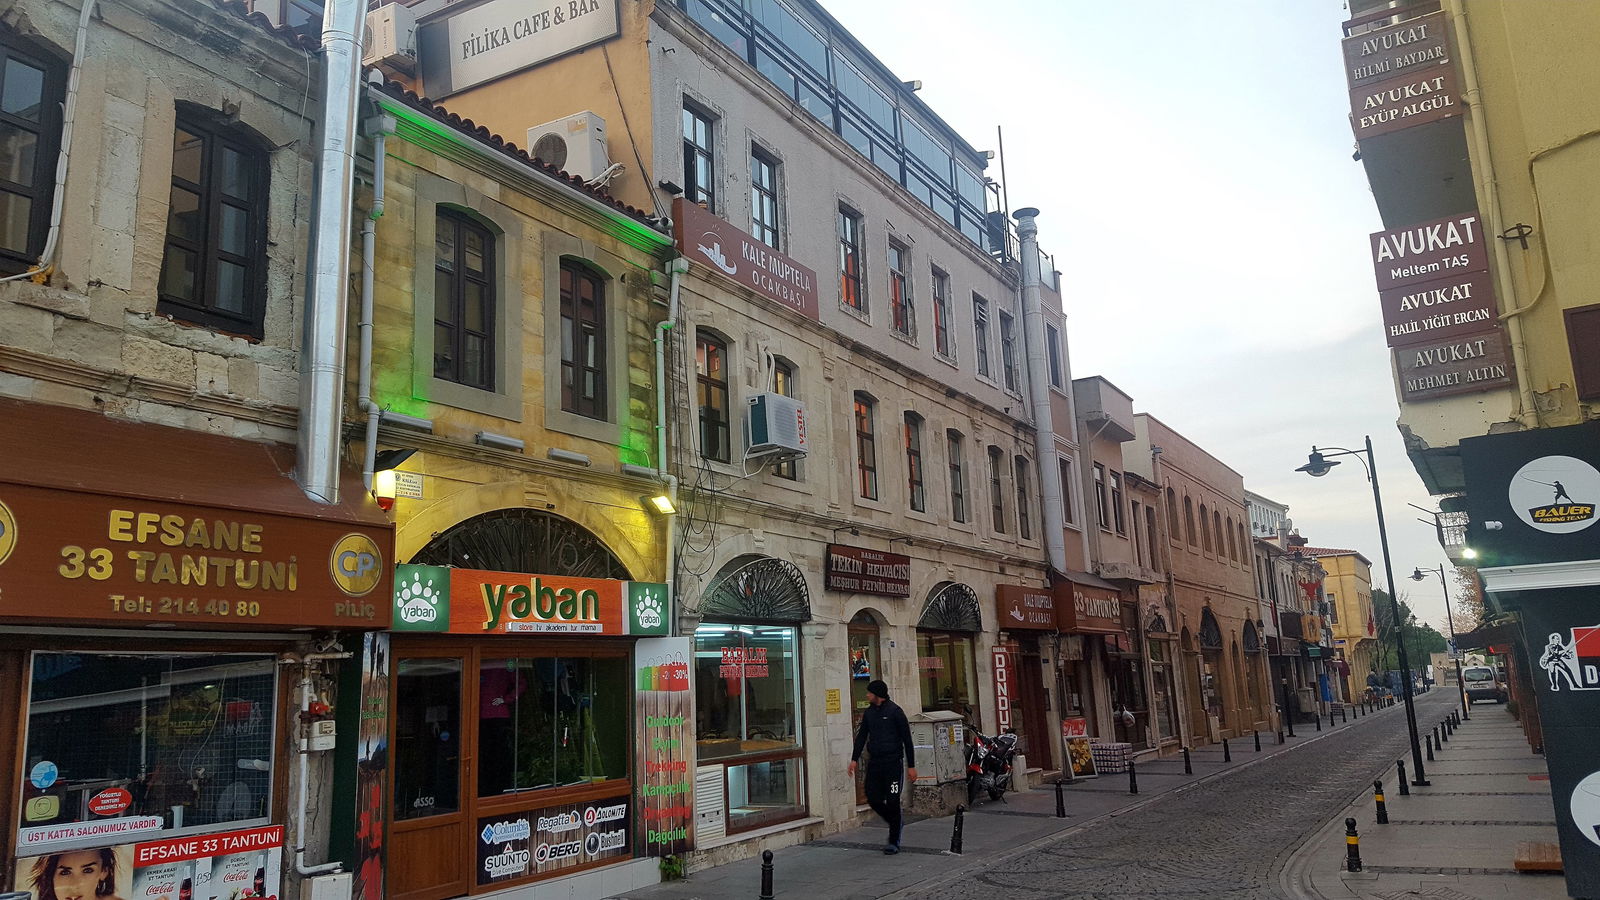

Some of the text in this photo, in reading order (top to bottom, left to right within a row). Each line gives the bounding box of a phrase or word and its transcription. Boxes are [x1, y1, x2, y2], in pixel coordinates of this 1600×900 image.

[462, 26, 511, 60] FİLİKA
[513, 10, 551, 40] CAFE
[553, 6, 565, 26] &
[1361, 24, 1428, 57] AVUKAT
[1353, 45, 1444, 80] HİLMİ BAYDAR
[1363, 76, 1445, 110] AVUKAT
[1360, 94, 1454, 129] EYÜP ALGÜL
[1377, 216, 1476, 263] AVUKAT
[742, 240, 812, 293] KALE MÜPTELA
[1391, 253, 1470, 280] Meltem TAŞ
[752, 270, 806, 309] OCAKBAŞI
[1399, 282, 1473, 313] AVUKAT
[1390, 307, 1491, 337] HALİL YİĞİT ERCAN
[1415, 339, 1486, 368] AVUKAT
[1407, 364, 1507, 392] MEHMET ALTIN
[1534, 505, 1592, 518] BAUER
[108, 508, 264, 554] EFSANE
[58, 545, 299, 592] 33 TANTUNİ
[337, 549, 376, 579] CP
[830, 553, 911, 581] TEKİN HELVACISI
[830, 575, 860, 591] MEŞHUR
[109, 594, 261, 618] Tel: 214 40 80
[334, 599, 376, 620] PİLİÇ
[403, 605, 436, 620] yaban
[480, 577, 599, 630] yaban
[1074, 591, 1120, 619] 33 TANTUNİ 33
[640, 614, 661, 625] yaban
[721, 647, 767, 664] BABALIK
[646, 715, 685, 728] Outdoor
[645, 760, 687, 773] Trekking
[890, 784, 899, 794] 33
[28, 818, 157, 842] ÜST KATTA SALONUMUZ VARDIR
[494, 819, 529, 836] Columbia
[539, 813, 570, 830] Regatta
[140, 828, 280, 862] EFSANE 33 TANTUNİ
[549, 843, 580, 858] BERG
[486, 851, 529, 870] SUUNTO
